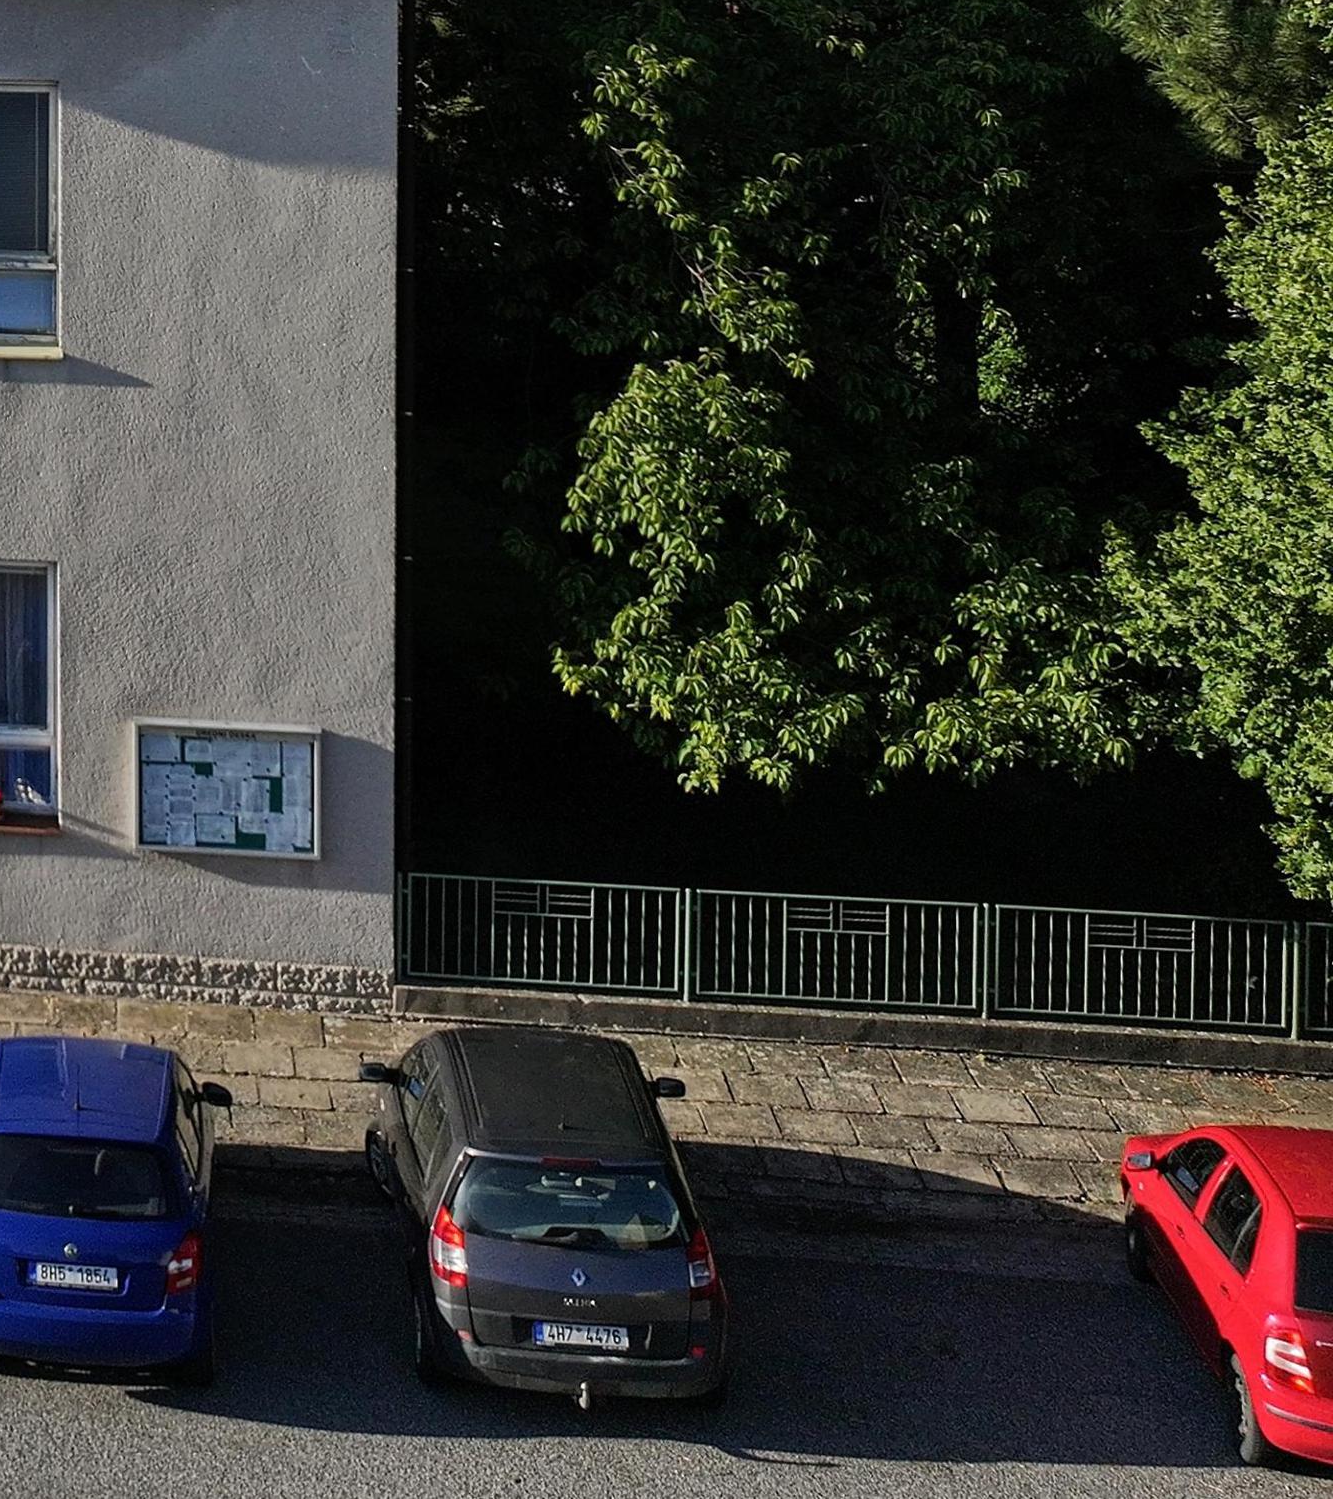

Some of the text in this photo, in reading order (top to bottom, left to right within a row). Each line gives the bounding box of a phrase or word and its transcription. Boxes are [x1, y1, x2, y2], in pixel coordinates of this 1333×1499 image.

[40, 1264, 111, 1285] 8H5 1854
[547, 1324, 622, 1345] 4H7 4476
